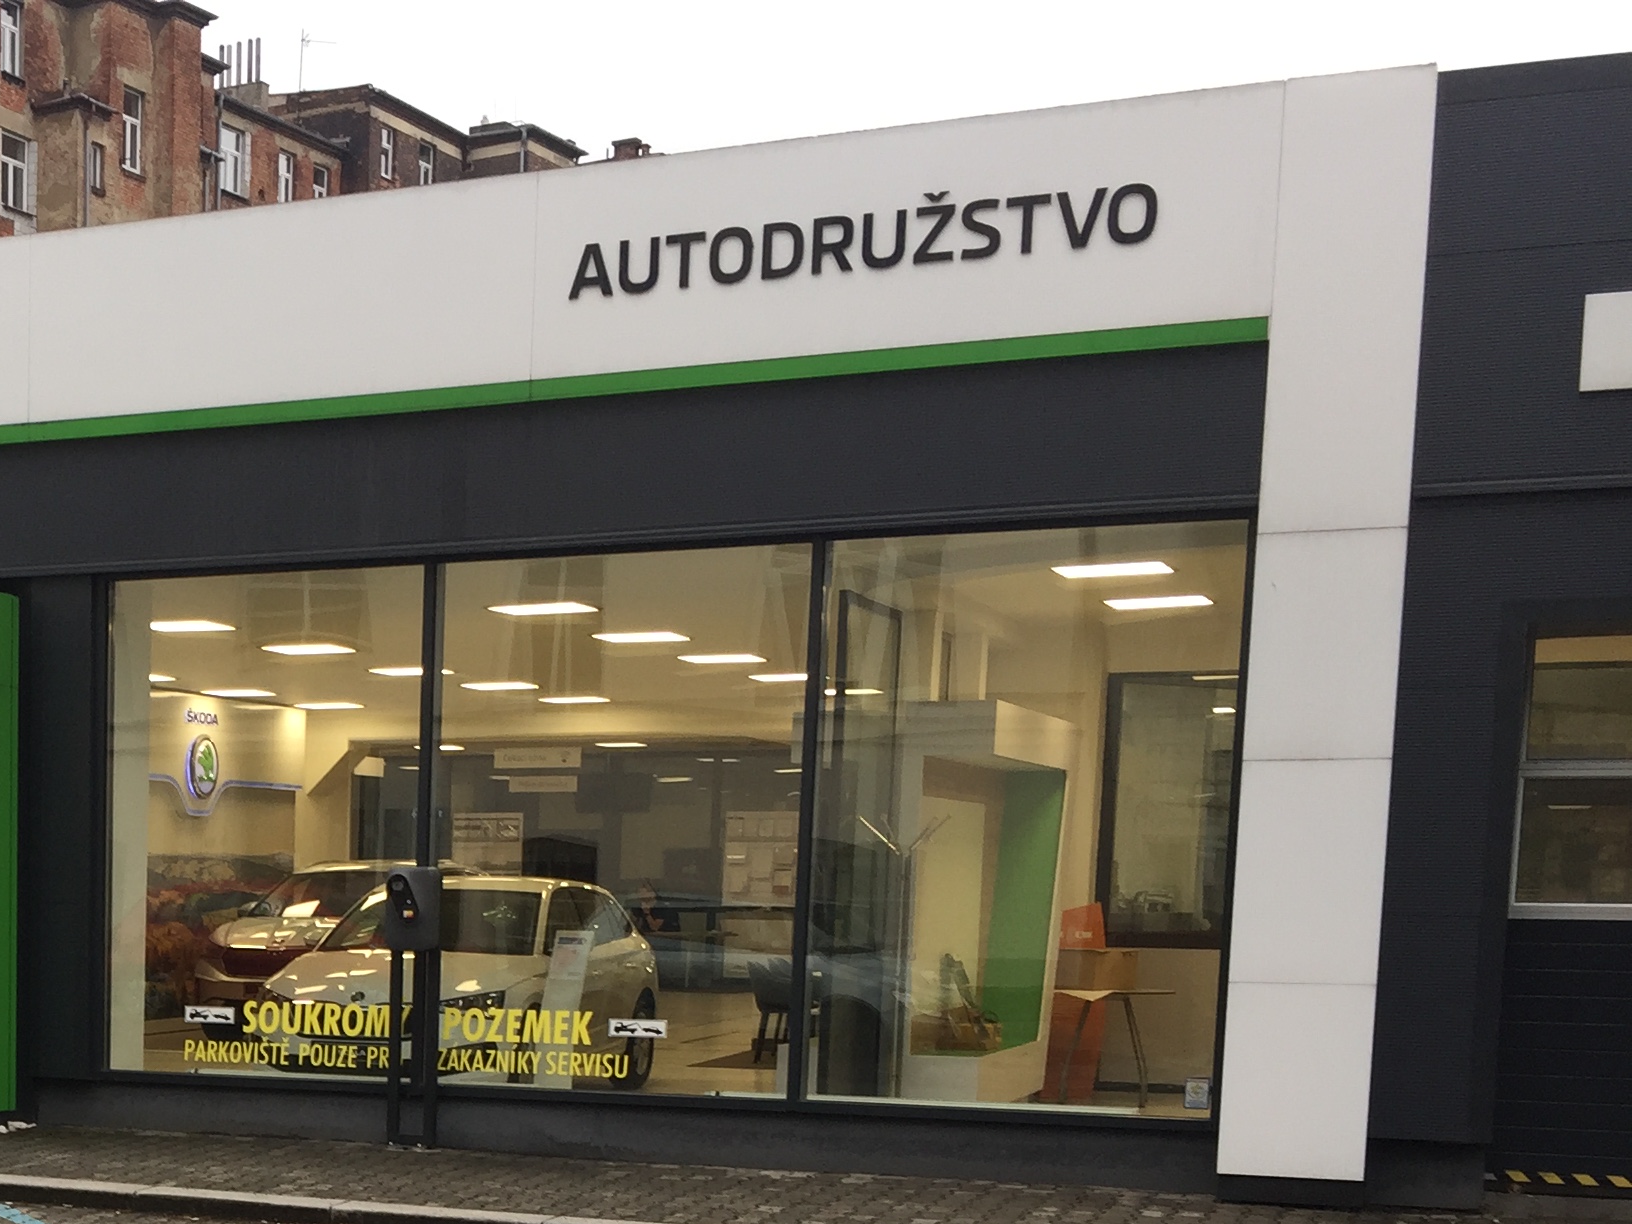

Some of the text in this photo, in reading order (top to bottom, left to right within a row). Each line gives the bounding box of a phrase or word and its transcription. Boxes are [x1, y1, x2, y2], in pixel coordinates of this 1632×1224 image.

[568, 182, 1159, 300] AUTODRUŽSTVO
[185, 707, 220, 726] ŠKODA
[441, 1006, 594, 1046] POZEMEK
[183, 1036, 290, 1066] PARKOVIŠTĚ
[298, 1042, 359, 1069] POUZE
[436, 1042, 540, 1076] ZÁKAZNÍKY
[545, 1052, 630, 1079] SERVISU
